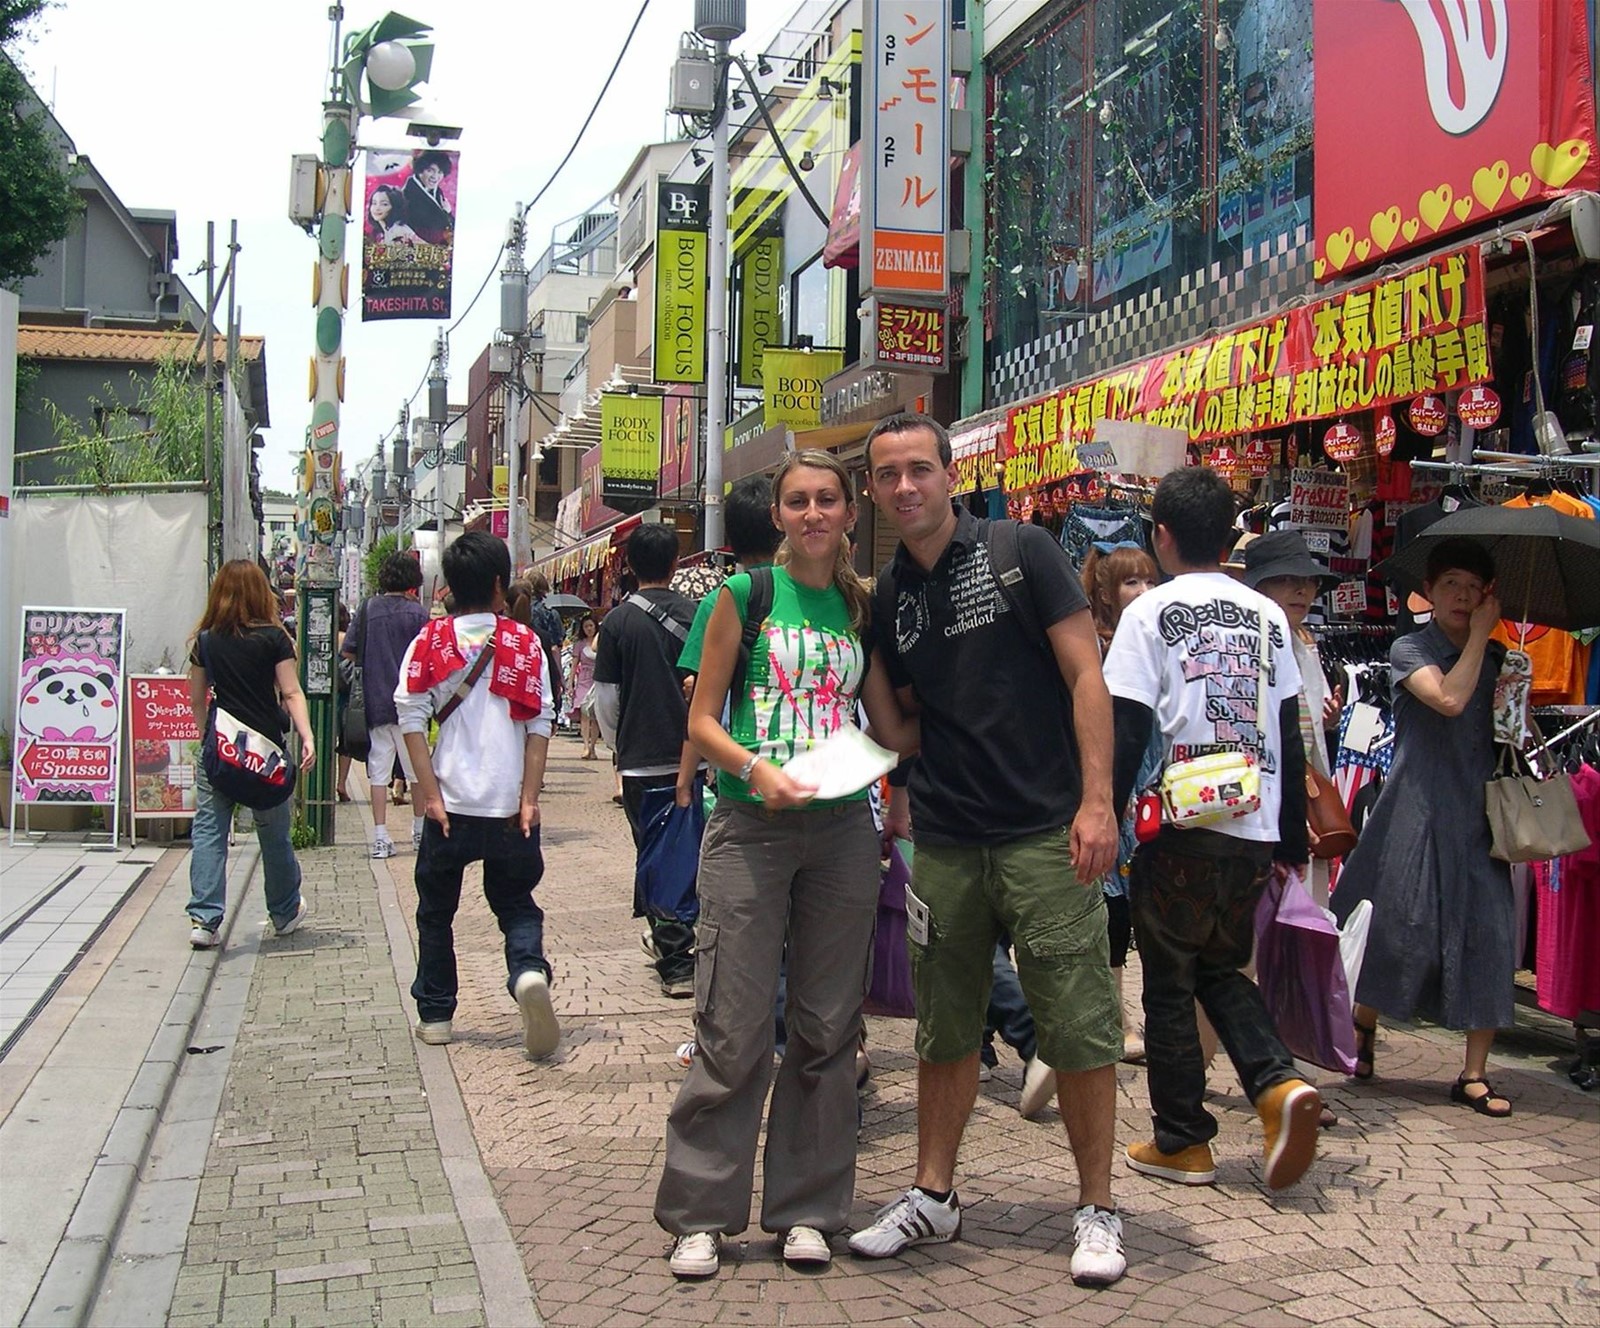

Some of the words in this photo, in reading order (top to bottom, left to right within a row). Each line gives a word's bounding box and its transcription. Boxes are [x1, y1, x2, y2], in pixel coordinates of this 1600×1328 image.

[901, 13, 937, 208] ンモール
[678, 238, 695, 295] BODY
[876, 247, 942, 274] ZENMALL
[366, 297, 428, 313] TAKESHITA
[1312, 253, 1466, 364] 本気値下げ
[880, 307, 942, 332] ミラクル
[675, 304, 694, 375] FOCUS
[878, 328, 893, 341] GO!
[896, 331, 942, 353] セール
[883, 337, 898, 351] GO!
[1160, 317, 1288, 403] 本気値下げ
[1293, 322, 1490, 420] 利益なしの最終手段
[778, 377, 825, 394] BODY
[613, 417, 651, 429] BODY
[1417, 423, 1438, 433] SALE
[1468, 417, 1492, 426] SALE
[608, 429, 654, 442] FOCUS
[1333, 450, 1355, 458] SALE
[1293, 485, 1349, 509] PreSALE
[1337, 590, 1361, 603] 2F
[30, 616, 115, 634] ロリパンダ
[60, 636, 116, 656] くつ下
[136, 682, 158, 699] 3F
[31, 762, 41, 770] 1F
[41, 761, 108, 779] Spasso
